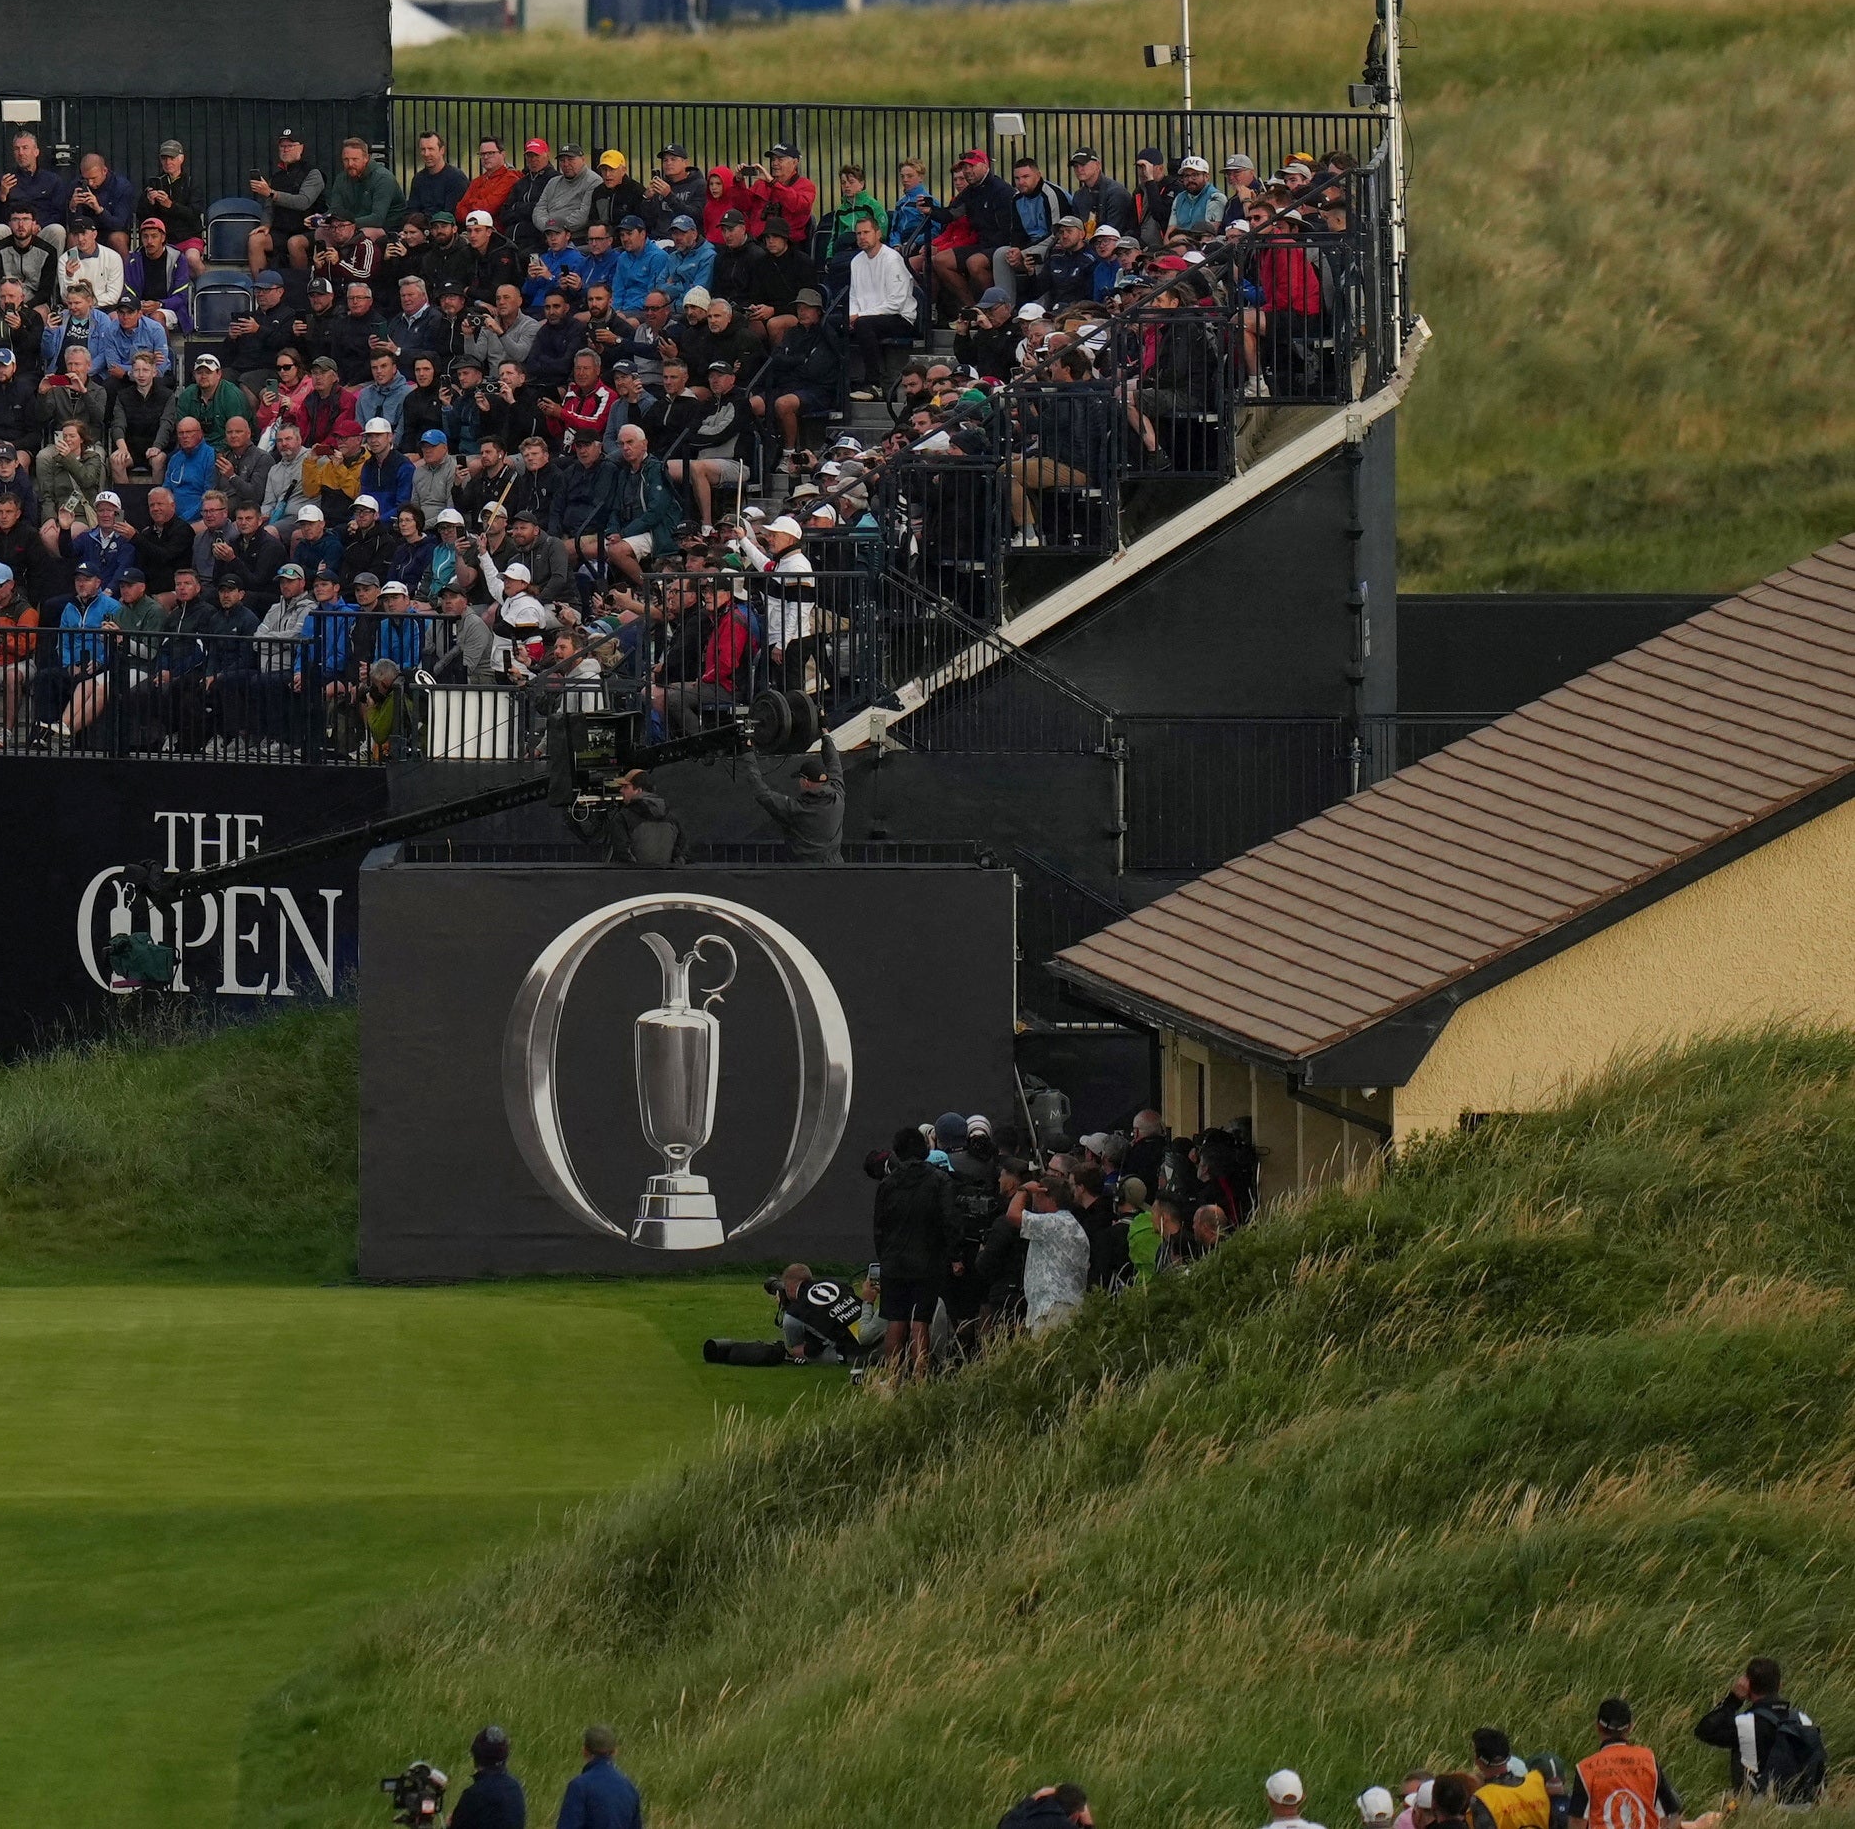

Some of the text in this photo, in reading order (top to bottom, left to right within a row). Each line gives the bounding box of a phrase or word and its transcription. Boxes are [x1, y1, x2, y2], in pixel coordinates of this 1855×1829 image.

[154, 811, 263, 873] THE
[828, 1296, 856, 1318] Official
[837, 1304, 861, 1323] Photo
